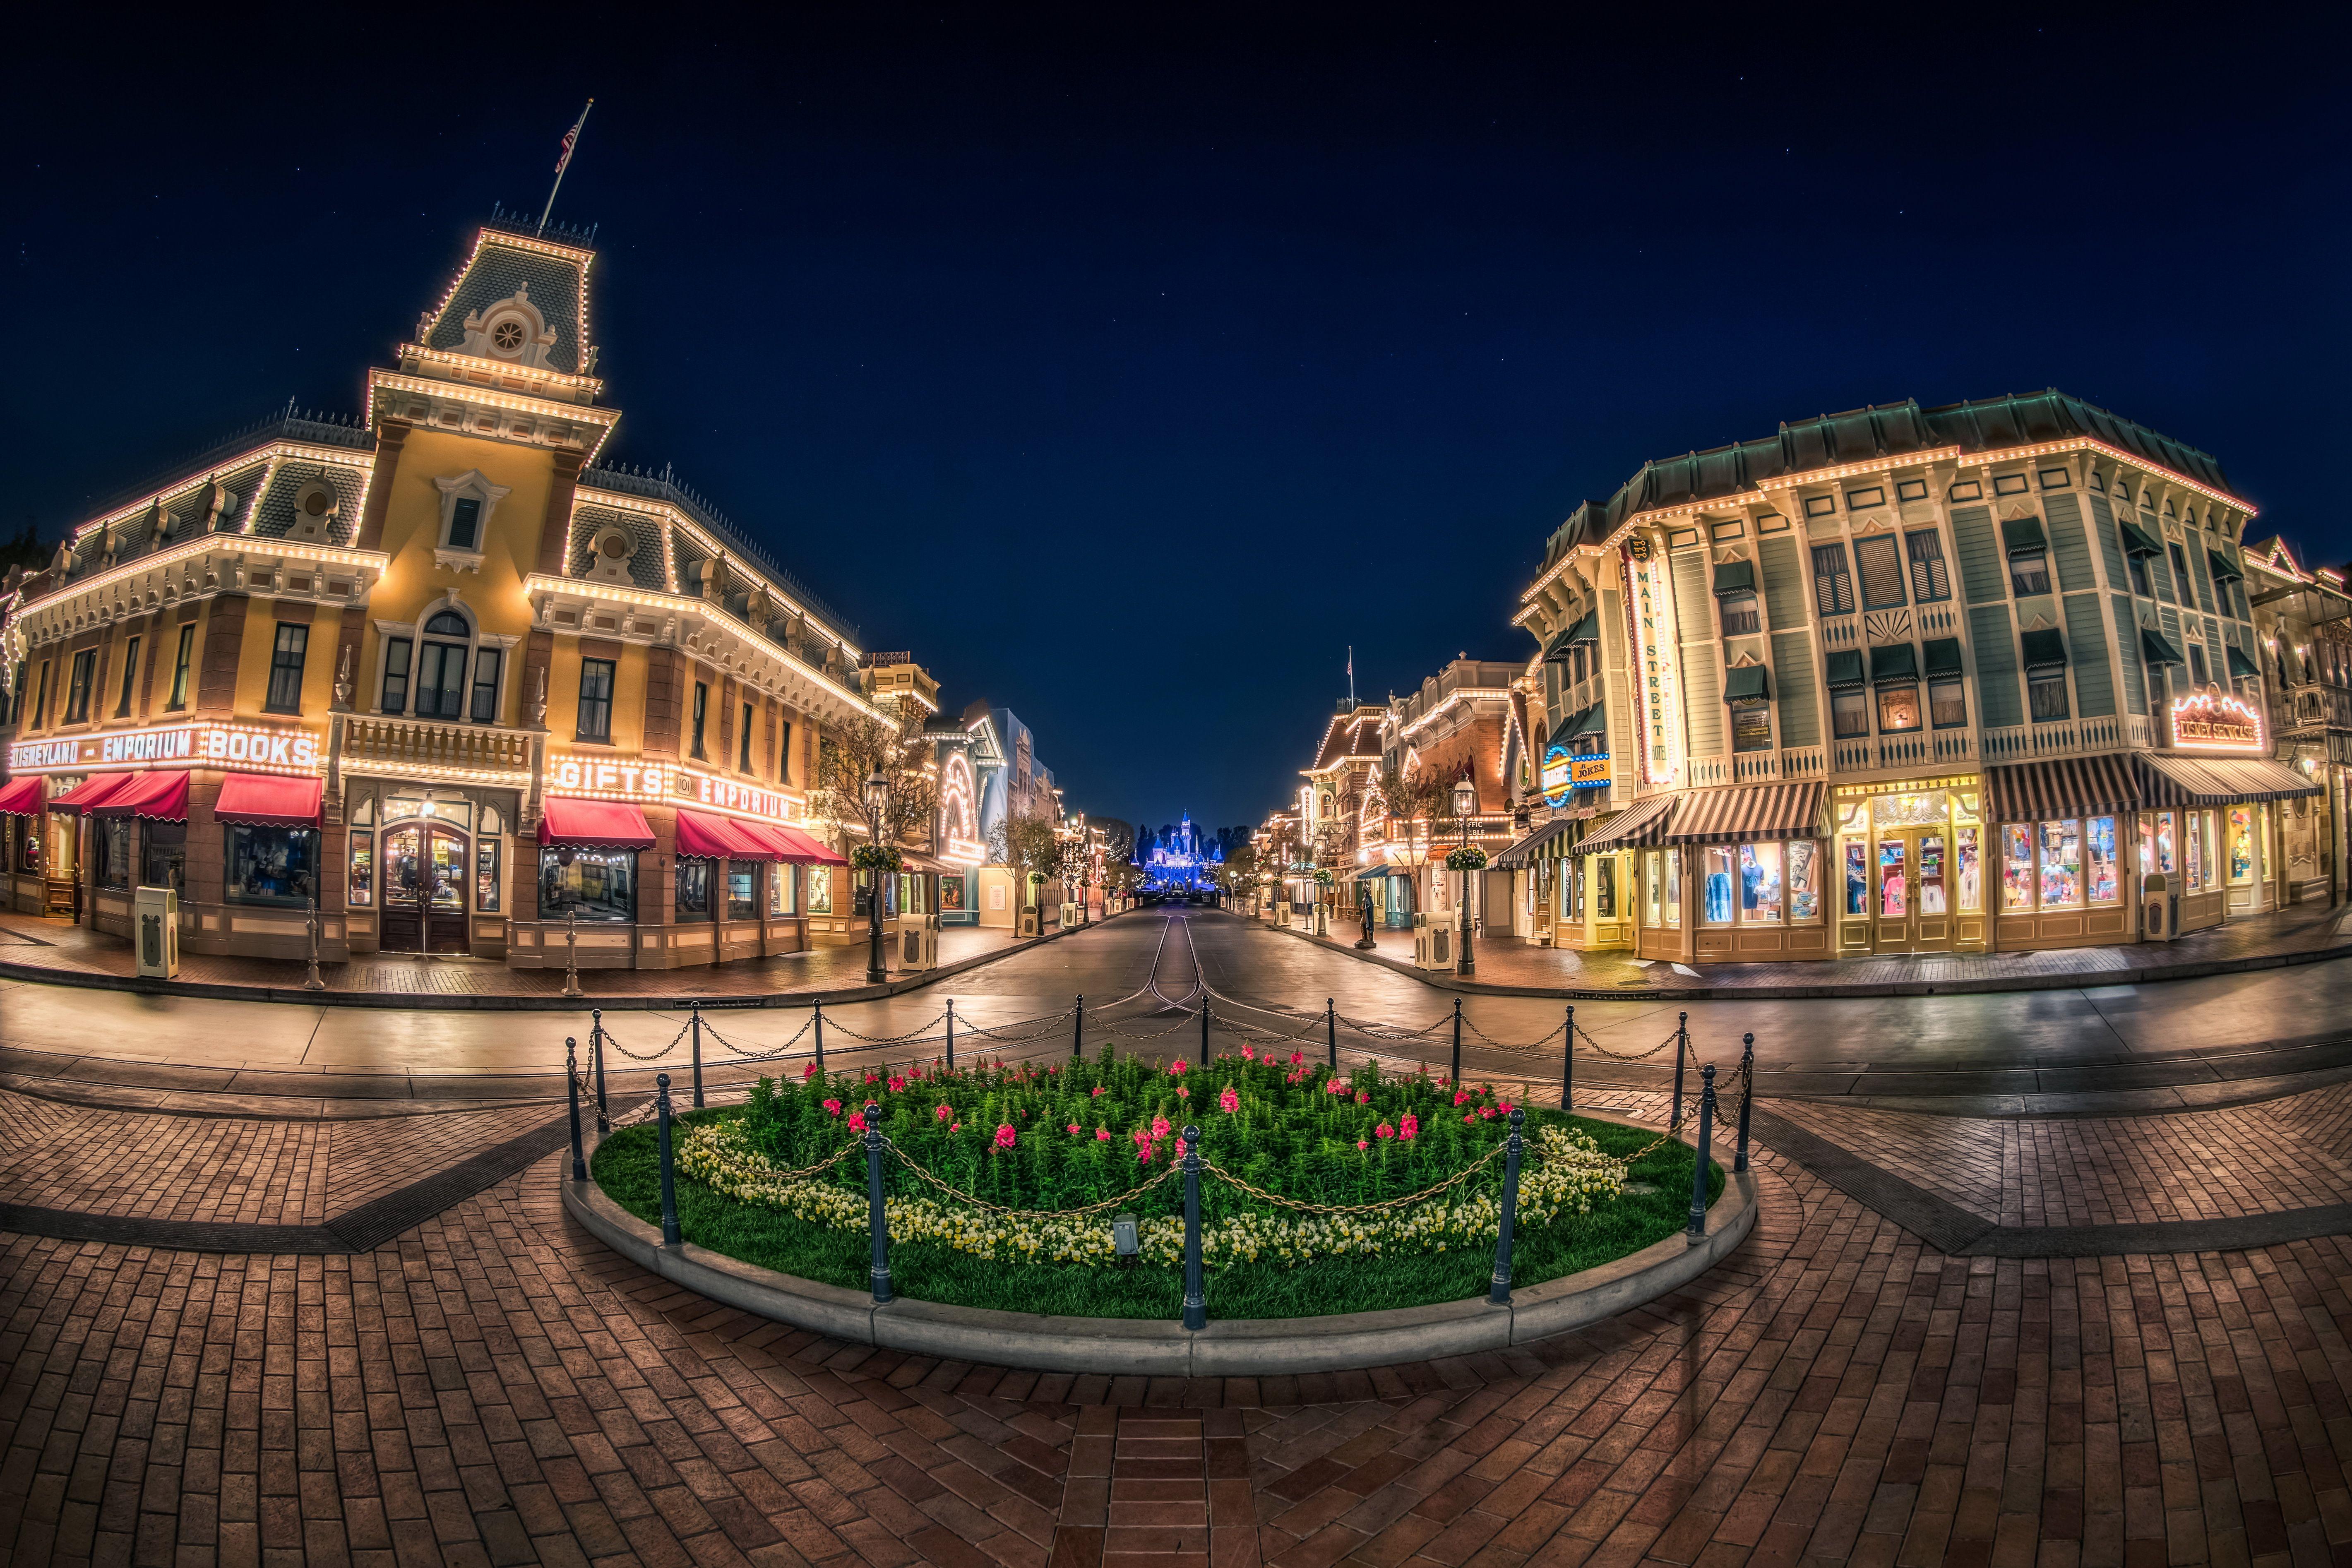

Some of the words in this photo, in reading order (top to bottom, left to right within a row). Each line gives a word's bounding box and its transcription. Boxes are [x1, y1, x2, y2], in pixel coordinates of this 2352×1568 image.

[1637, 571, 1654, 629] MAIN
[1646, 645, 1663, 736] STREET
[2180, 720, 2212, 738] DISNEY
[12, 741, 79, 767] DISNEYLAND
[103, 730, 192, 761] EMPORIUM
[207, 730, 313, 766] BOOKS
[1651, 745, 1667, 760] HOTEL
[560, 762, 663, 794] GIFTS
[679, 778, 690, 792] 101
[1578, 764, 1605, 778] JOKES
[701, 778, 789, 819] EMPORIUM
